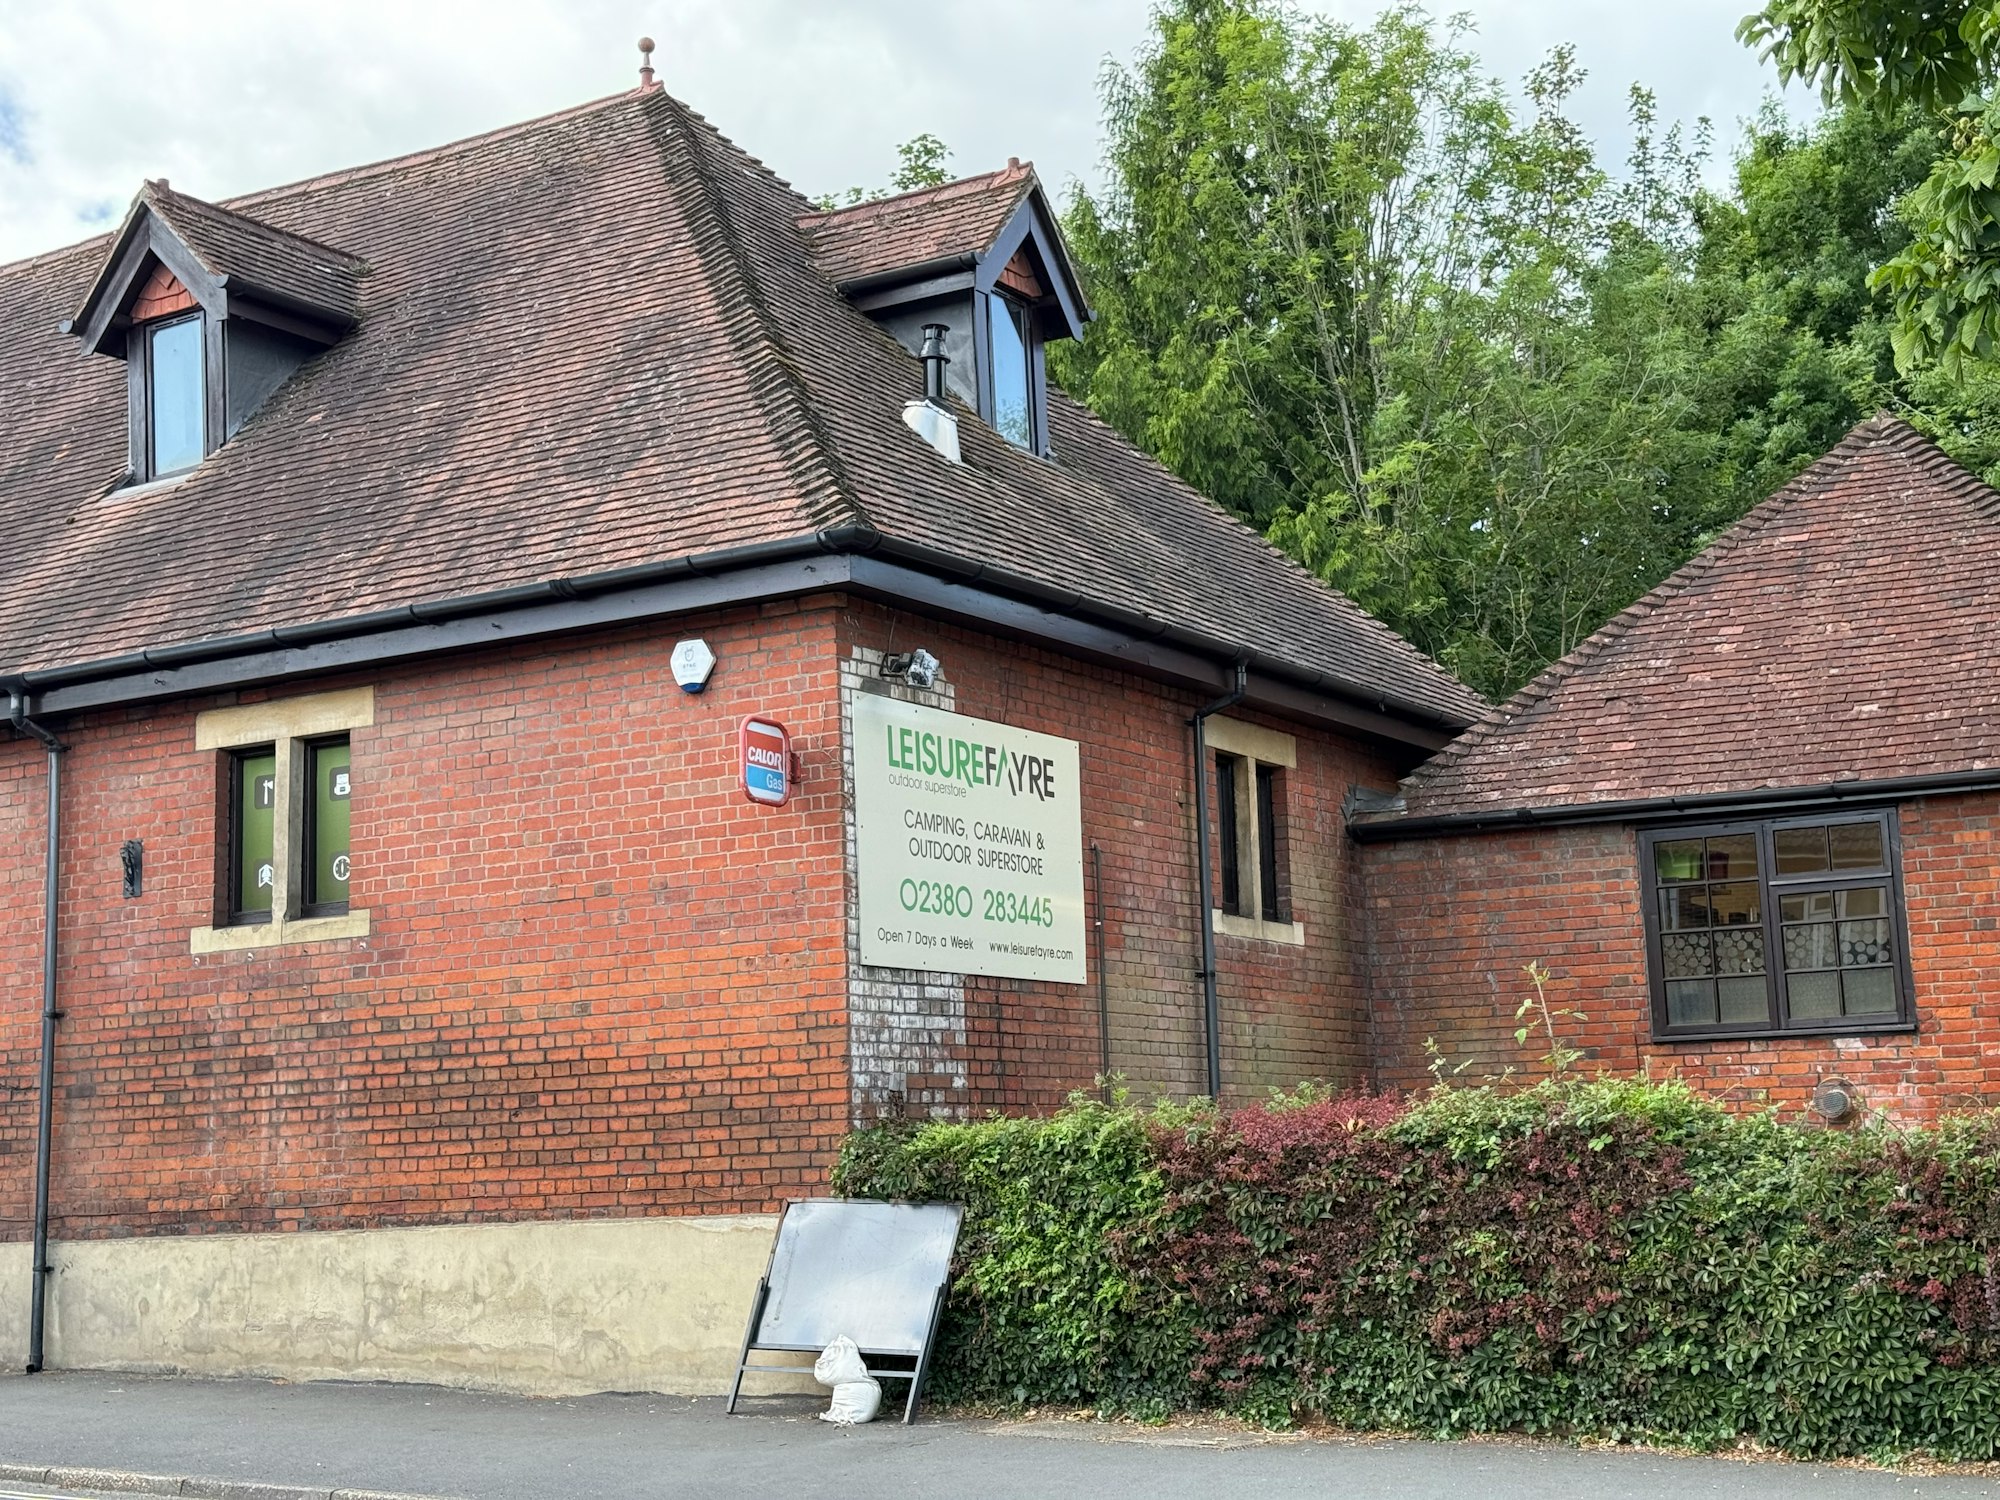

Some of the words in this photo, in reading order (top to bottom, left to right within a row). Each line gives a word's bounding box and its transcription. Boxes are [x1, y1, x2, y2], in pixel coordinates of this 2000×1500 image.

[748, 747, 782, 771] CALOR
[887, 725, 1055, 801] LEISUREFAYRE
[766, 773, 782, 790] Gas
[889, 772, 922, 790] outdoor
[925, 779, 966, 798] superstore
[904, 809, 968, 840] CAMPING,
[974, 822, 1031, 848] CARAVAN
[1036, 833, 1045, 850] &
[909, 837, 971, 864] OUTDOOR
[977, 849, 1043, 875] SUPERSTORE
[900, 878, 972, 917] 02380
[984, 889, 1052, 927] 283445
[878, 927, 903, 946] Open
[907, 931, 912, 943] 7
[915, 932, 936, 949] Days
[941, 937, 947, 947] a
[950, 936, 974, 950] Week
[989, 941, 1073, 961] www.leisurefayre.com
